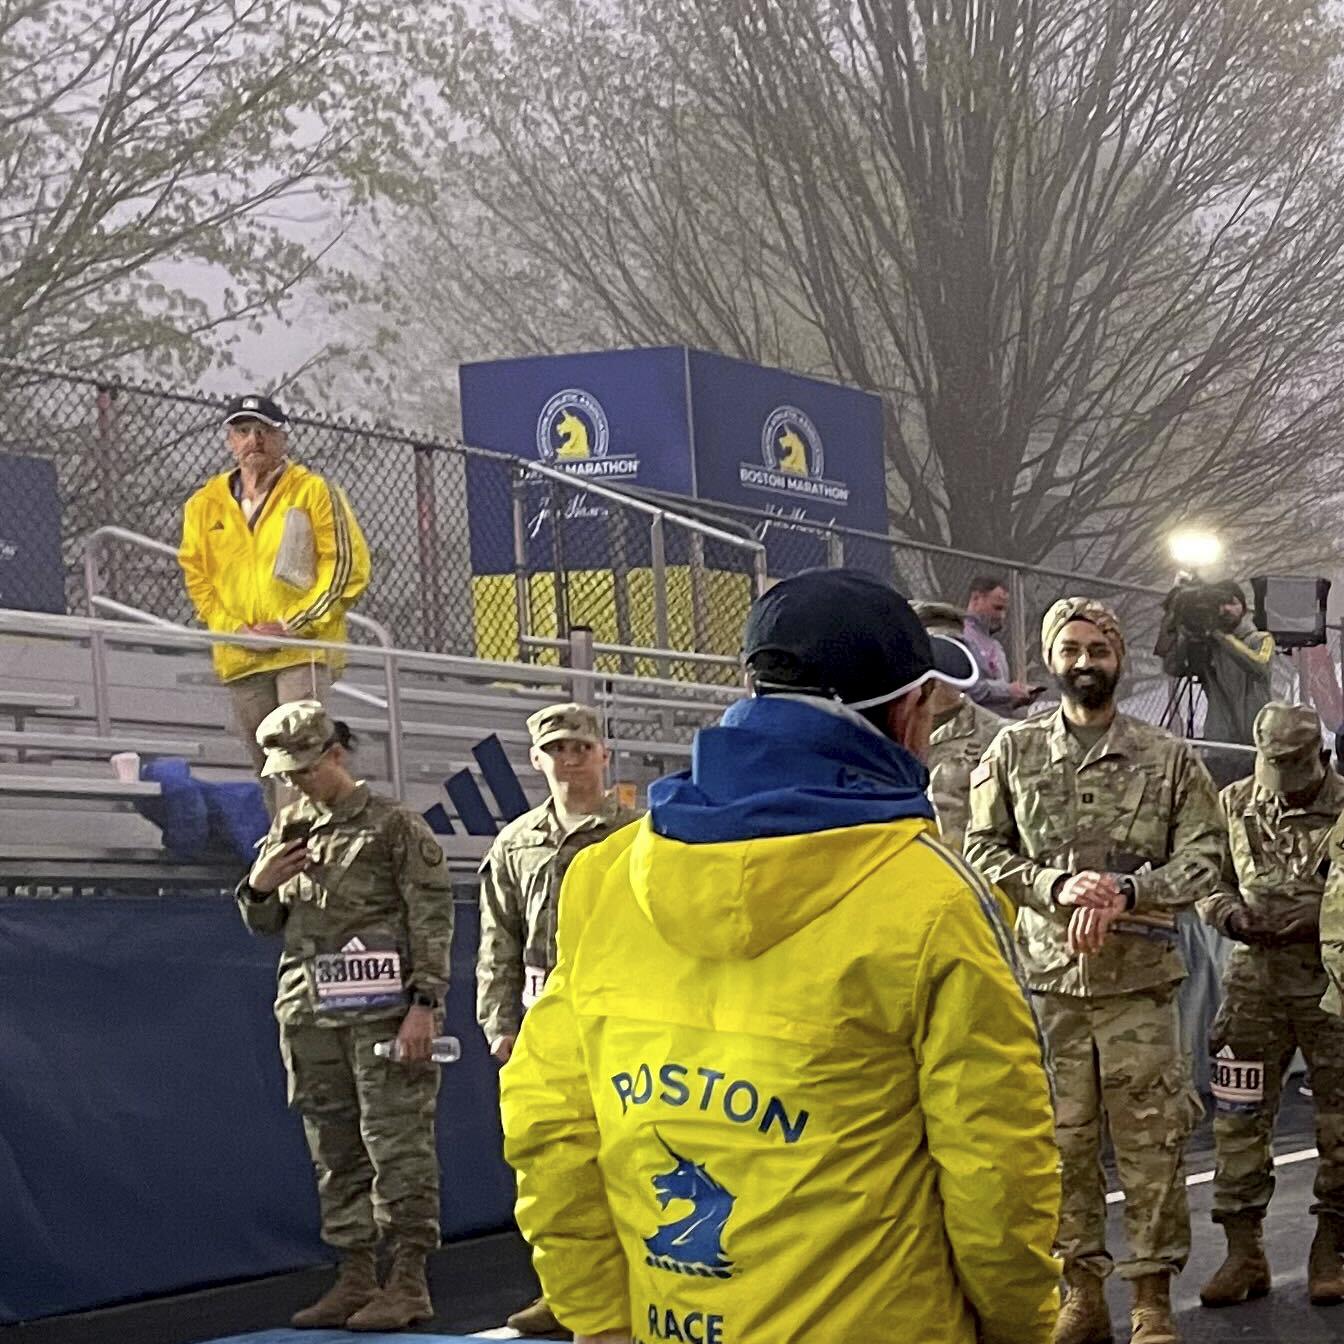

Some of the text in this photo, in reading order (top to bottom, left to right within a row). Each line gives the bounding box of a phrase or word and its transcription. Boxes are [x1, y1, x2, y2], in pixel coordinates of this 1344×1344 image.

[565, 461, 637, 475] MARATHON
[740, 469, 848, 500] BOSTON MARATHON
[318, 958, 396, 982] 33004
[1209, 1064, 1260, 1090] 3010
